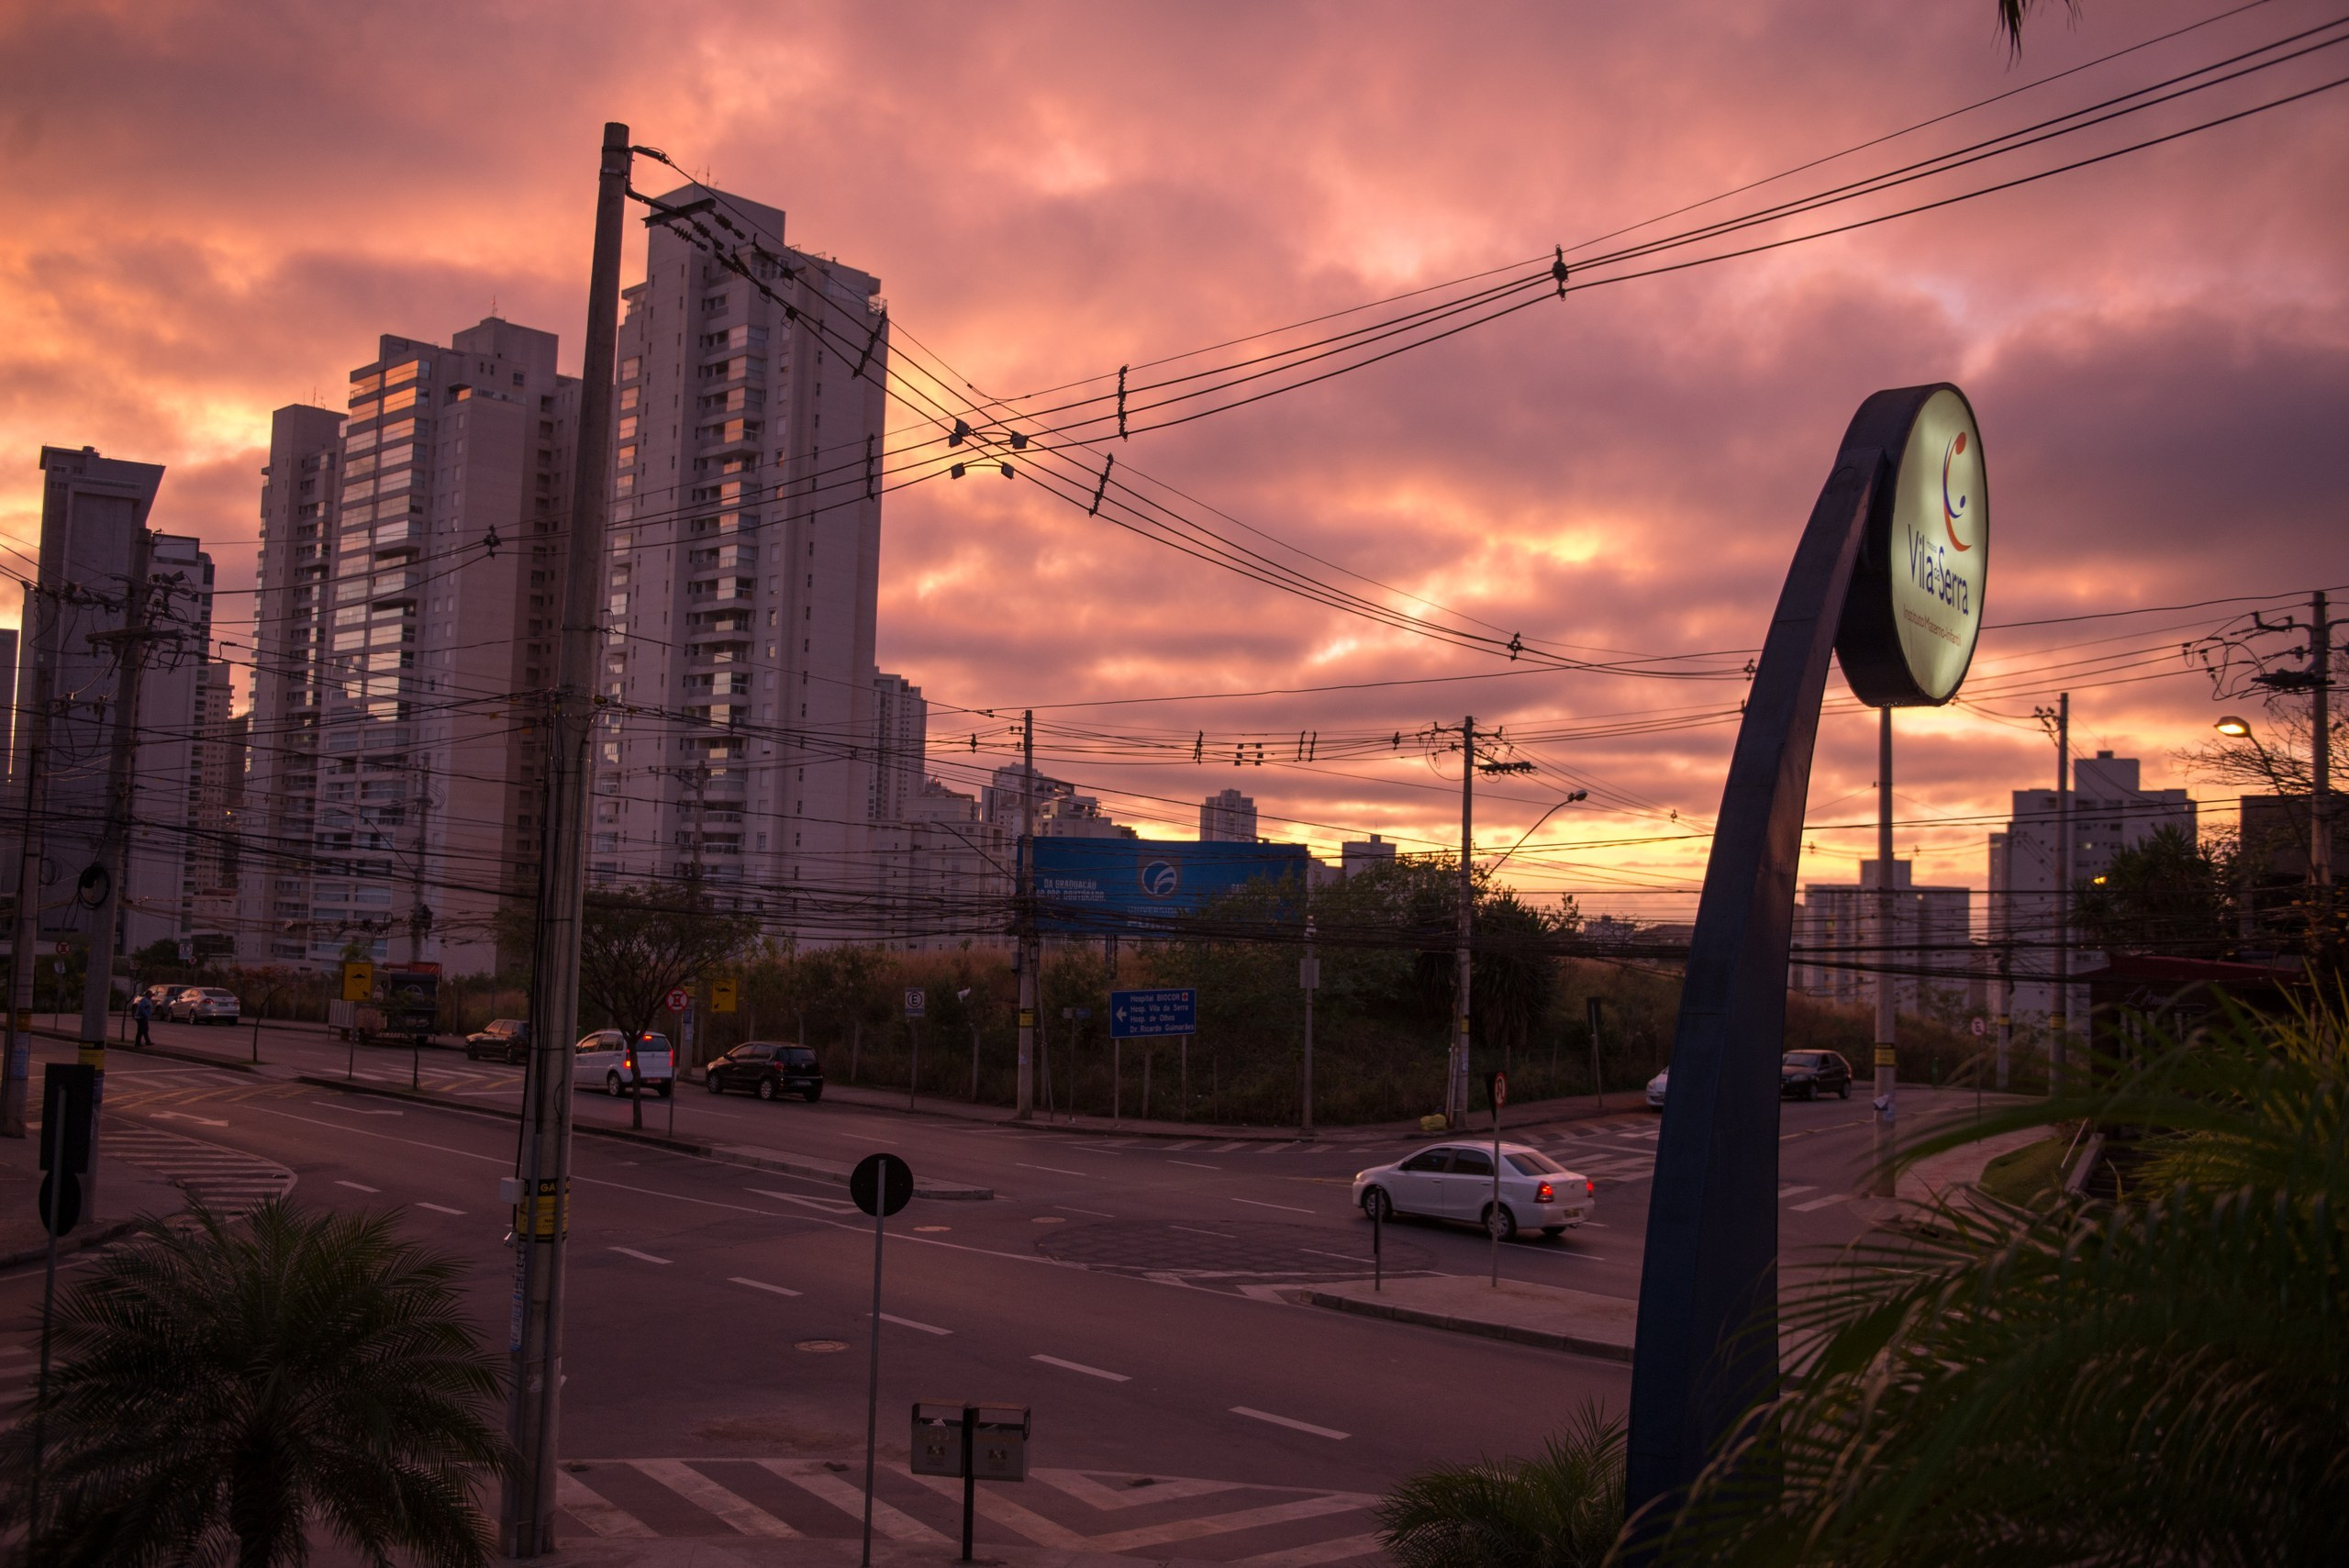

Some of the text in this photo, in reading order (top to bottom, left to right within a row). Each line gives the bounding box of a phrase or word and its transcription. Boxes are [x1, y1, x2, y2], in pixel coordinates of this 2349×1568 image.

[1908, 524, 1934, 595] Vila
[1939, 546, 1968, 616] Serra
[1044, 878, 1097, 890] DA GRADUAÇÃO
[912, 995, 918, 1005] E
[1130, 993, 1180, 1004] Hospital BIOCOR
[1141, 1024, 1162, 1032] Ricardo
[1165, 1023, 1194, 1032] Guimarães
